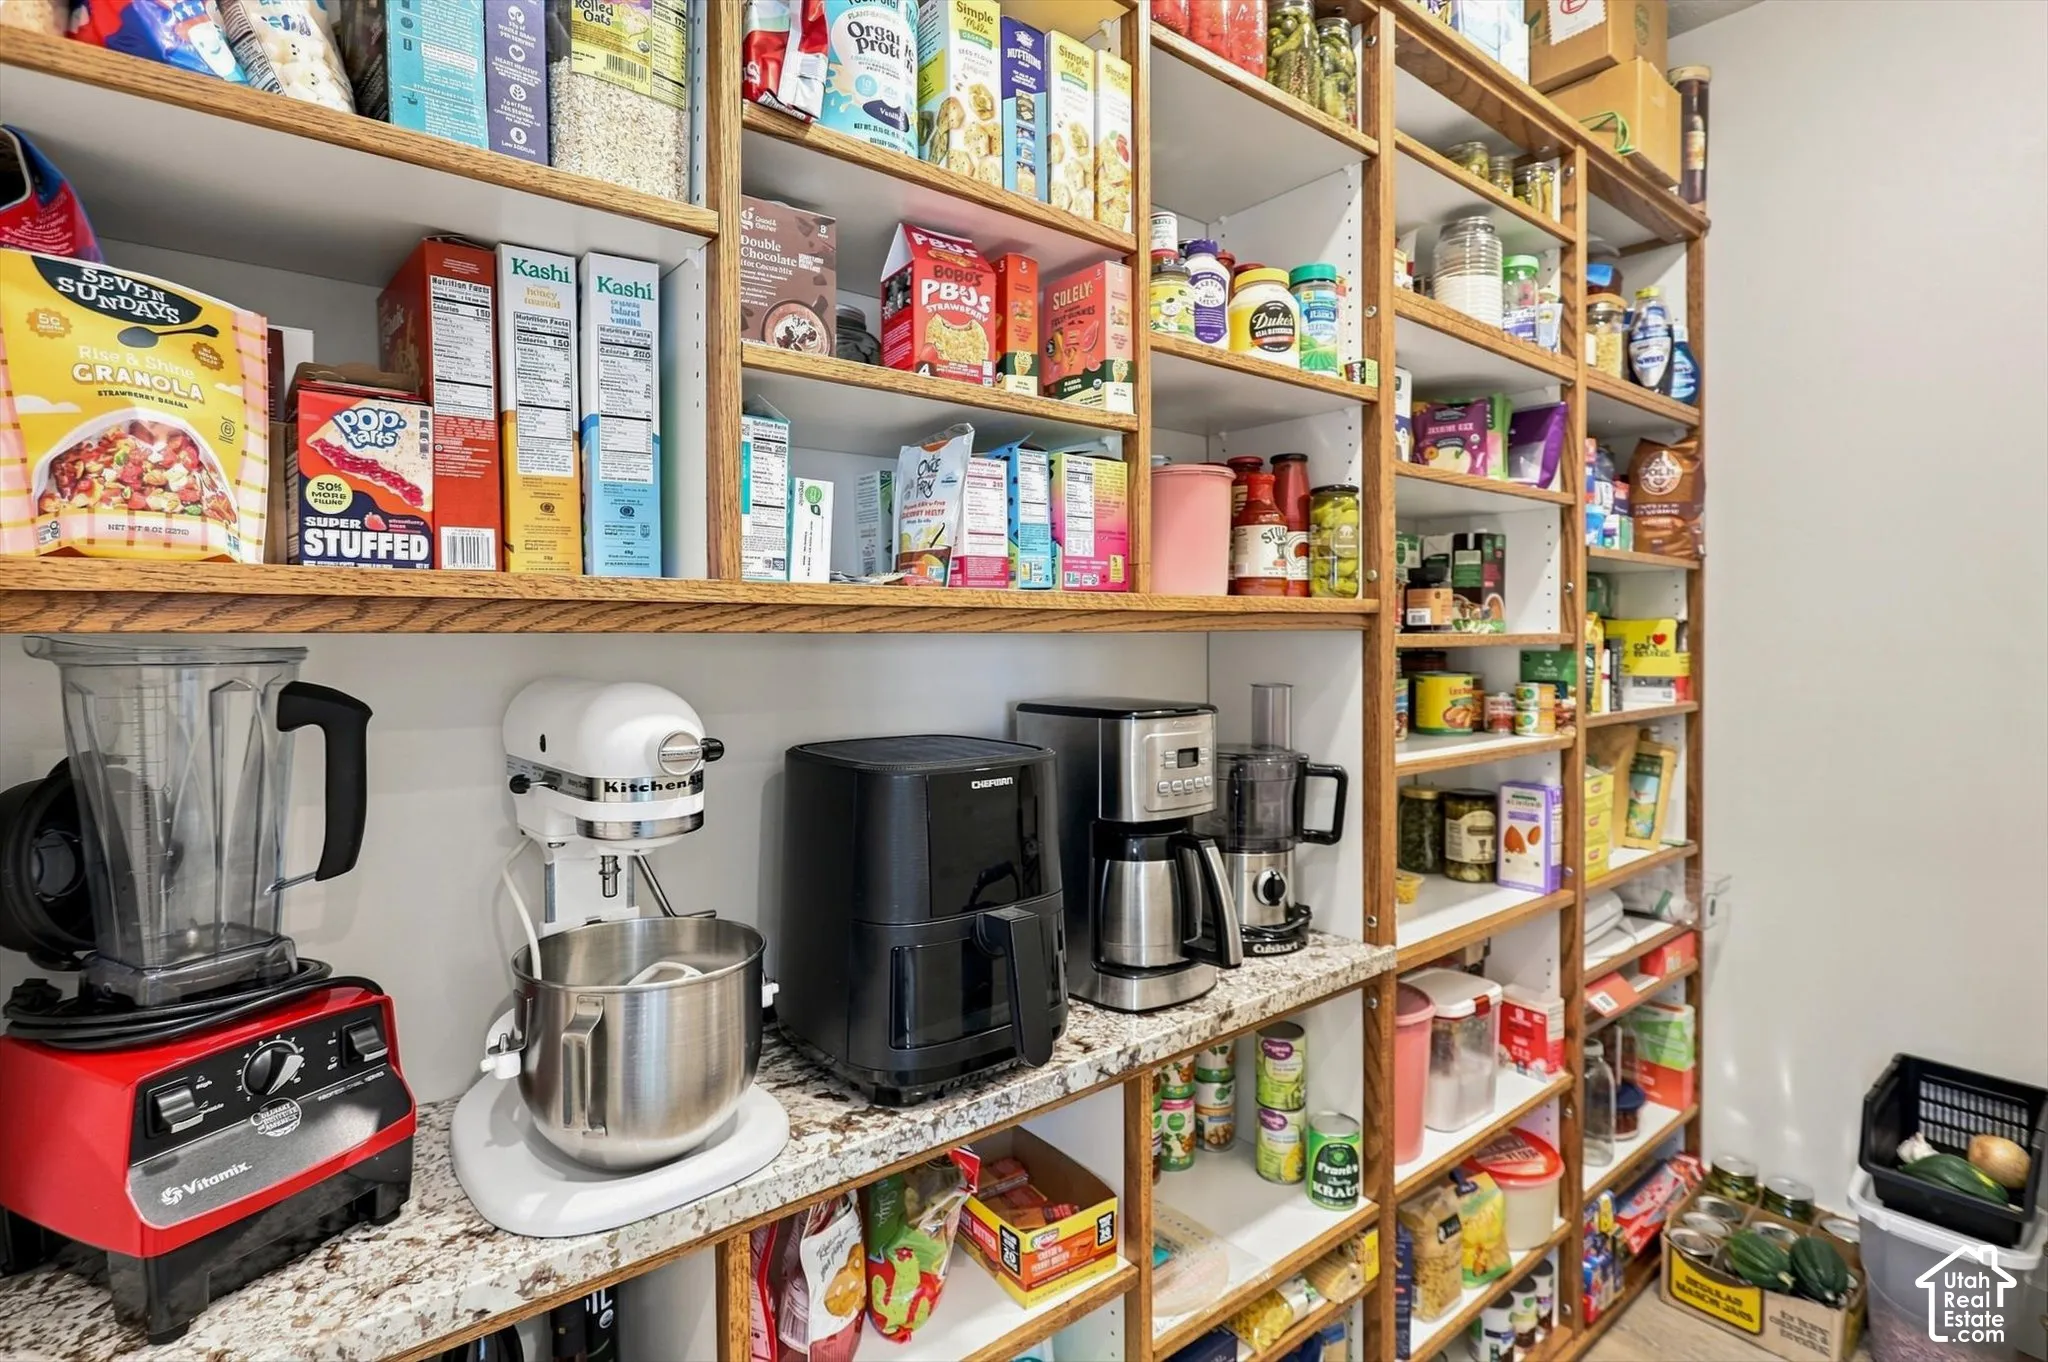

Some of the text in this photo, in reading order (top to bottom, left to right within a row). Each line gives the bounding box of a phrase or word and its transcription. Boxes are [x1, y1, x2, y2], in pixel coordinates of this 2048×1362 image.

[583, 10, 611, 26] Oats
[956, 1, 994, 25] Simple
[1059, 44, 1090, 67] Simple
[741, 234, 782, 253] Double
[741, 247, 797, 268] Chocolate
[511, 257, 572, 284] Kashi
[756, 262, 778, 273] Cocoa
[779, 266, 793, 276] Mix
[933, 265, 984, 287] BOBO'S
[81, 267, 165, 303] SEVEN
[597, 275, 654, 301] Kashi
[56, 276, 181, 324] SUNDAYS
[1053, 282, 1090, 310] SOLELY
[476, 308, 490, 318] 150
[516, 313, 569, 328] Nutrition Facts
[926, 302, 989, 322] STRAWBERRY
[1252, 311, 1293, 331] Duke's
[517, 335, 570, 348] Calories 150
[77, 345, 195, 380] Rise & Shine
[72, 363, 205, 404] GRANOLA
[97, 390, 189, 409] STRAWBERRY BANANA
[311, 491, 347, 500] MORE
[316, 482, 342, 493] 50%
[314, 498, 343, 506] FILLING
[108, 524, 126, 532] NET
[128, 525, 142, 533] WT
[304, 516, 362, 529] SUPER
[304, 529, 430, 562] STUFFED
[971, 776, 1013, 790] CHEFMAN
[182, 1162, 247, 1196] Vitamix
[1685, 1275, 1743, 1306] REGULAR
[1676, 1280, 1754, 1323] MASON JARS
